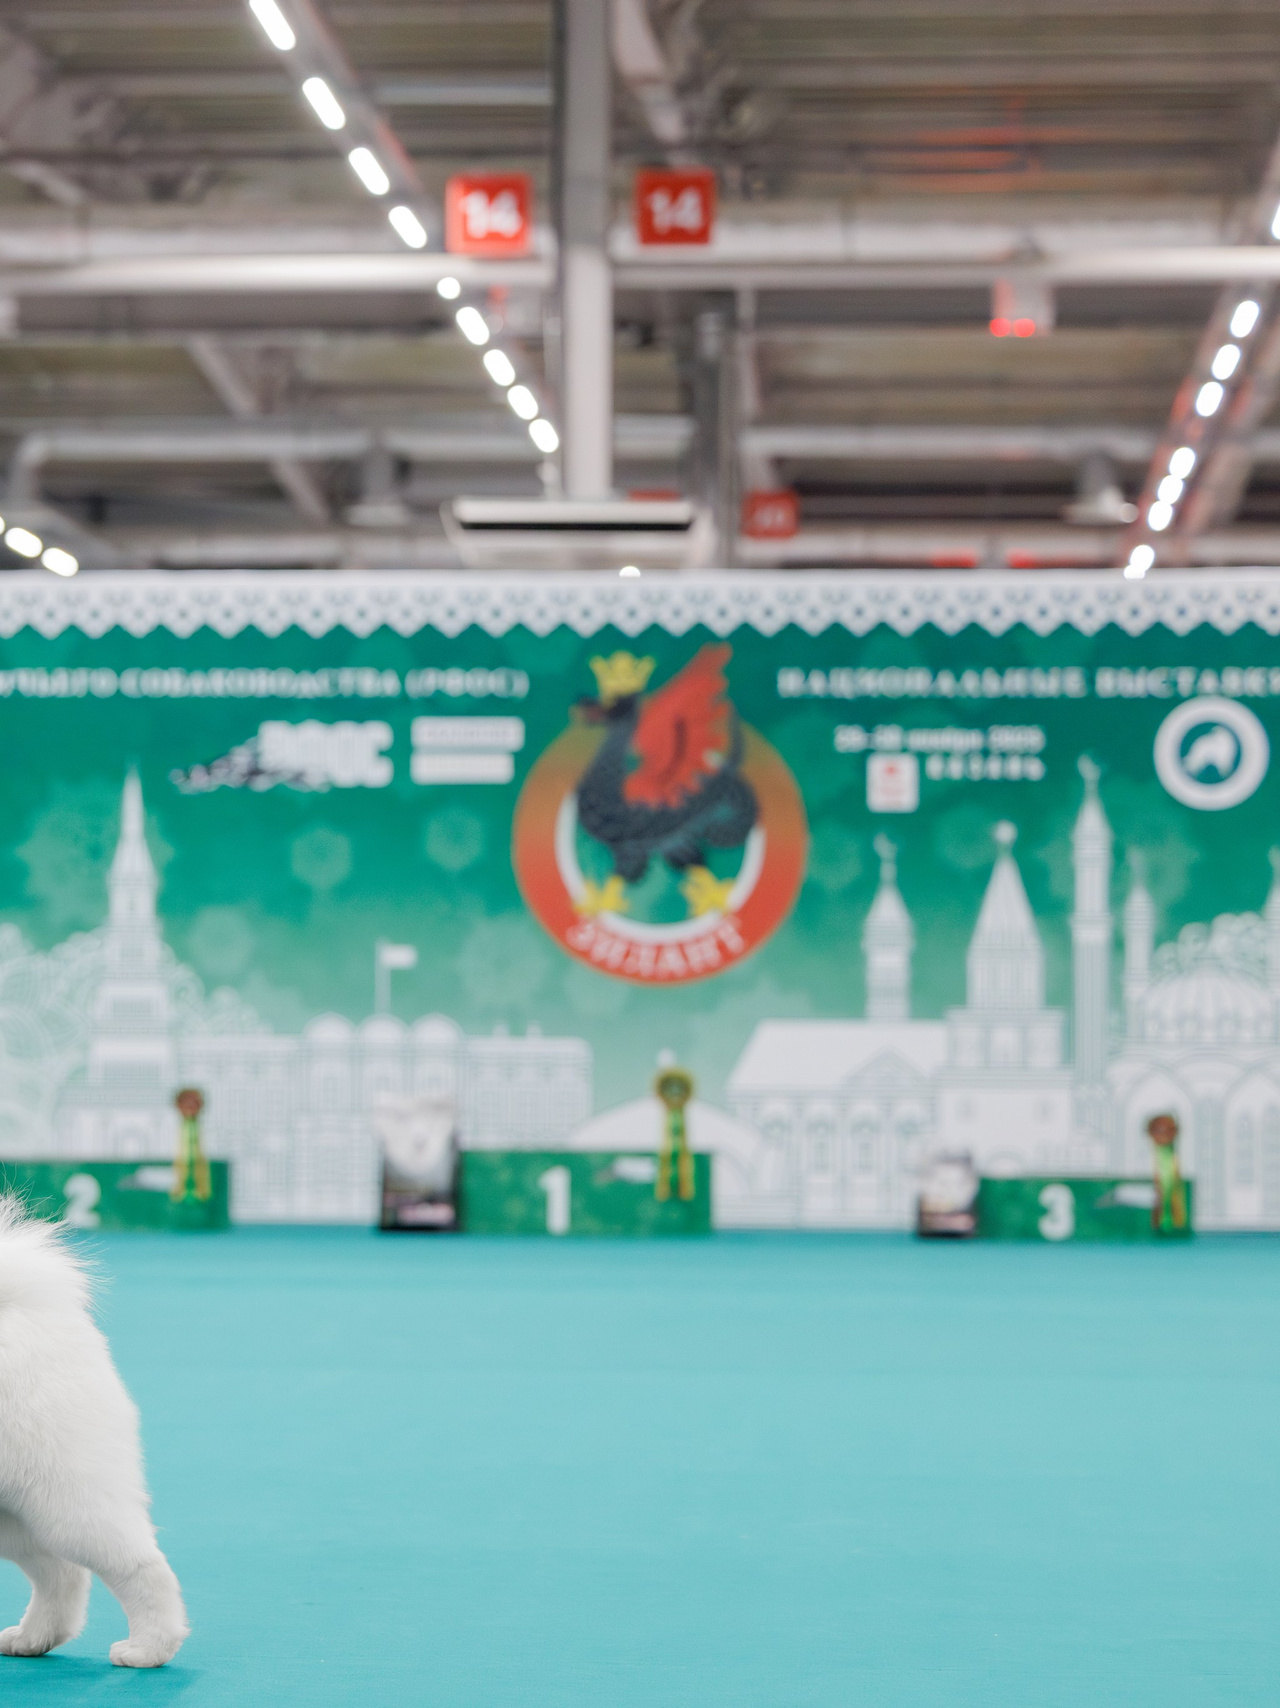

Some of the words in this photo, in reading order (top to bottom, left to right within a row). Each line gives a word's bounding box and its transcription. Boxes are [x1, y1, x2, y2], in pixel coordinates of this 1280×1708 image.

[461, 189, 522, 238] 14
[649, 187, 702, 234] 14
[63, 1173, 101, 1227] 2
[538, 1165, 570, 1235] 1
[1037, 1183, 1075, 1241] 3
